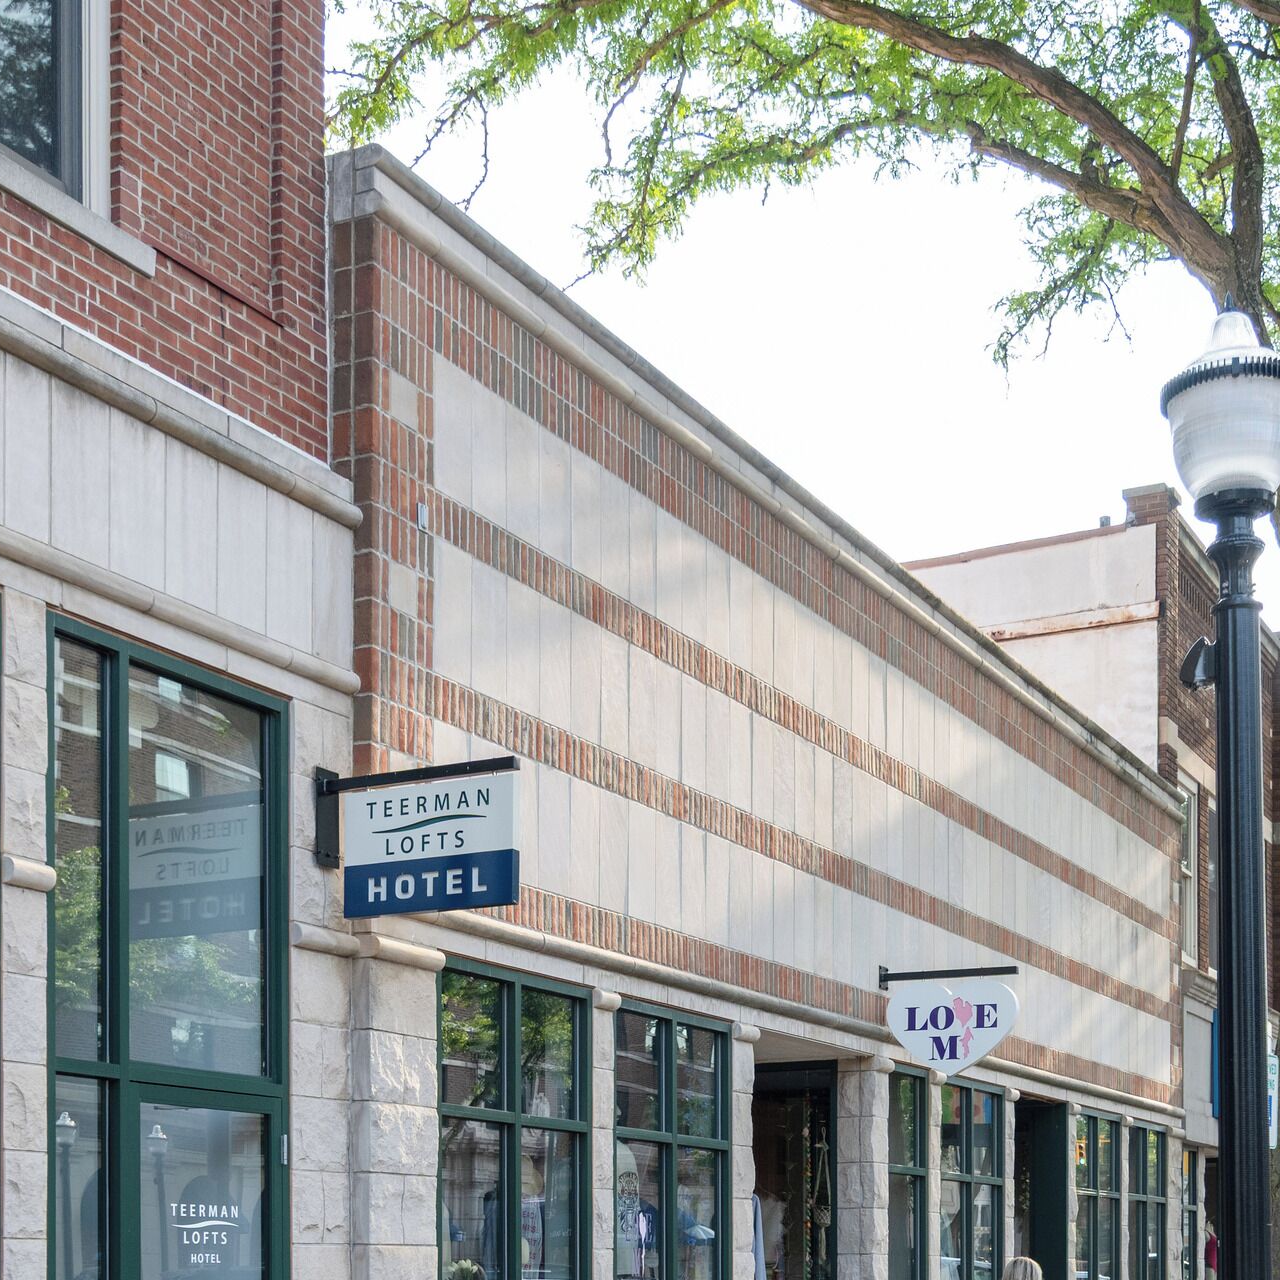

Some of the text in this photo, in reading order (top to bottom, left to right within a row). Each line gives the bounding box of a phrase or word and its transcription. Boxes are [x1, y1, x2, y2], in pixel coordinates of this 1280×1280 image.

[365, 787, 491, 820] TEERMAN
[384, 830, 466, 857] LOFTS
[367, 866, 488, 904] HOTEL
[170, 1203, 239, 1219] TEERMAN
[183, 1230, 228, 1245] LOFTS
[190, 1252, 221, 1264] HOTEL
